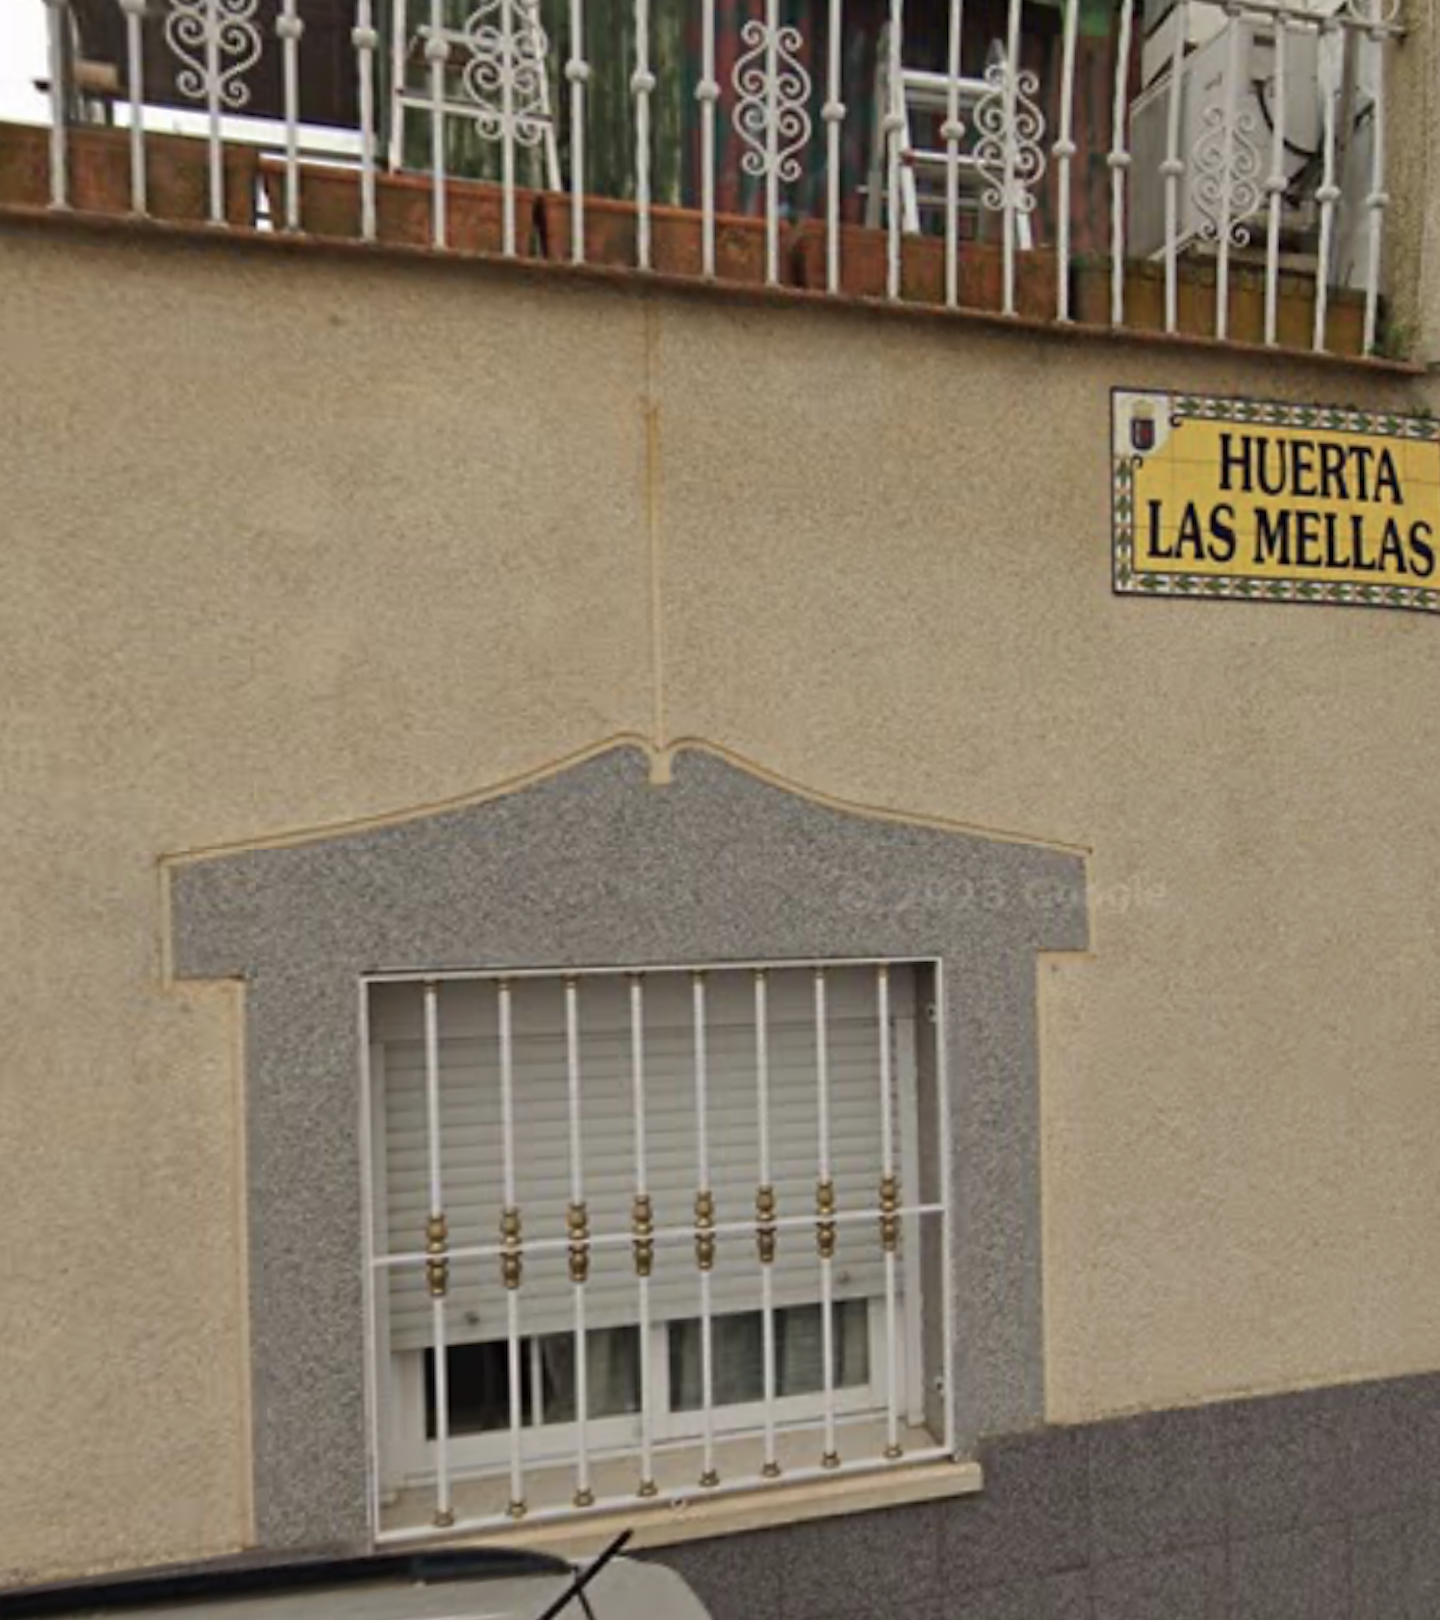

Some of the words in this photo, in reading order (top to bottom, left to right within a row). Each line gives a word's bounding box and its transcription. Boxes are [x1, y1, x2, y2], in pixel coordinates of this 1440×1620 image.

[1218, 432, 1404, 505] HUERTA
[1147, 499, 1238, 563] LAS
[1252, 507, 1436, 577] MELLAS
